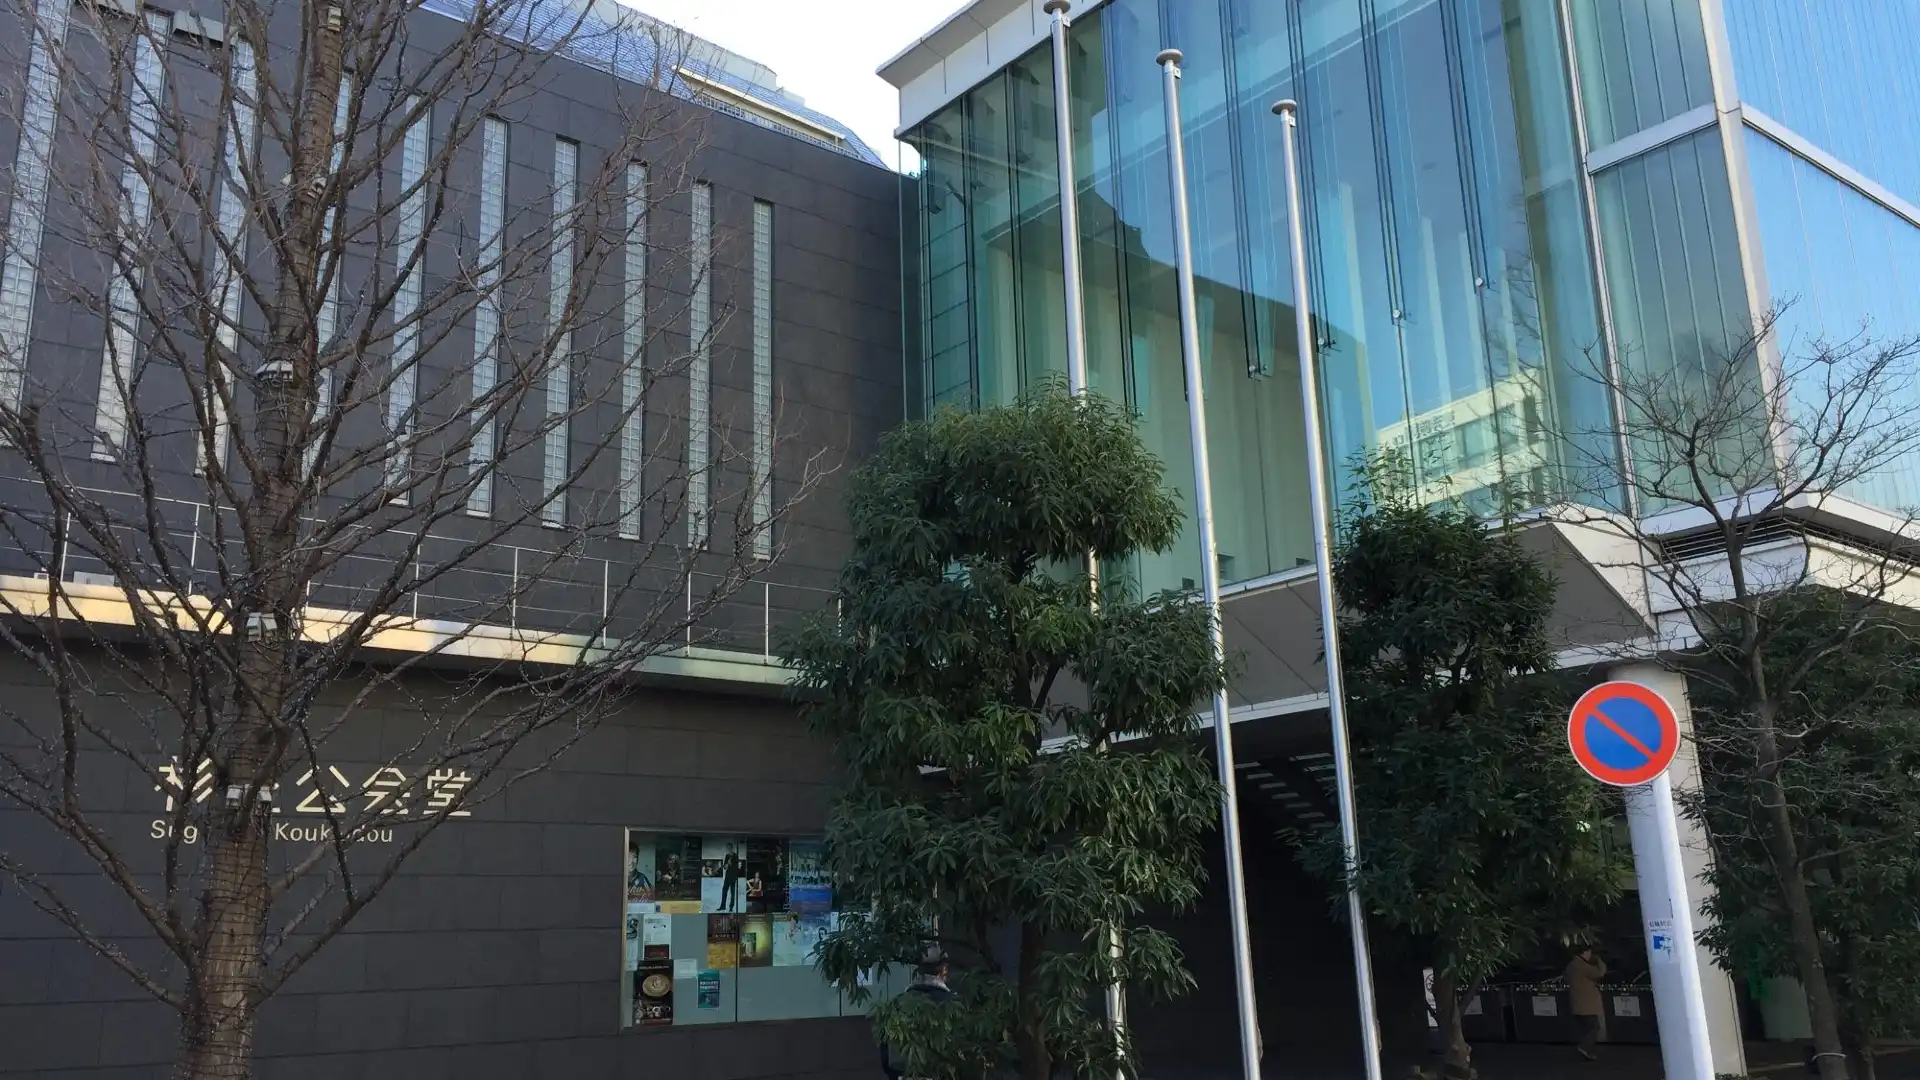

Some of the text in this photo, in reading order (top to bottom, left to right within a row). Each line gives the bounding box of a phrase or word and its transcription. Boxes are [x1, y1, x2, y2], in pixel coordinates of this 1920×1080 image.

[154, 756, 471, 817] 杉公会堂
[275, 823, 392, 843] Koukou
